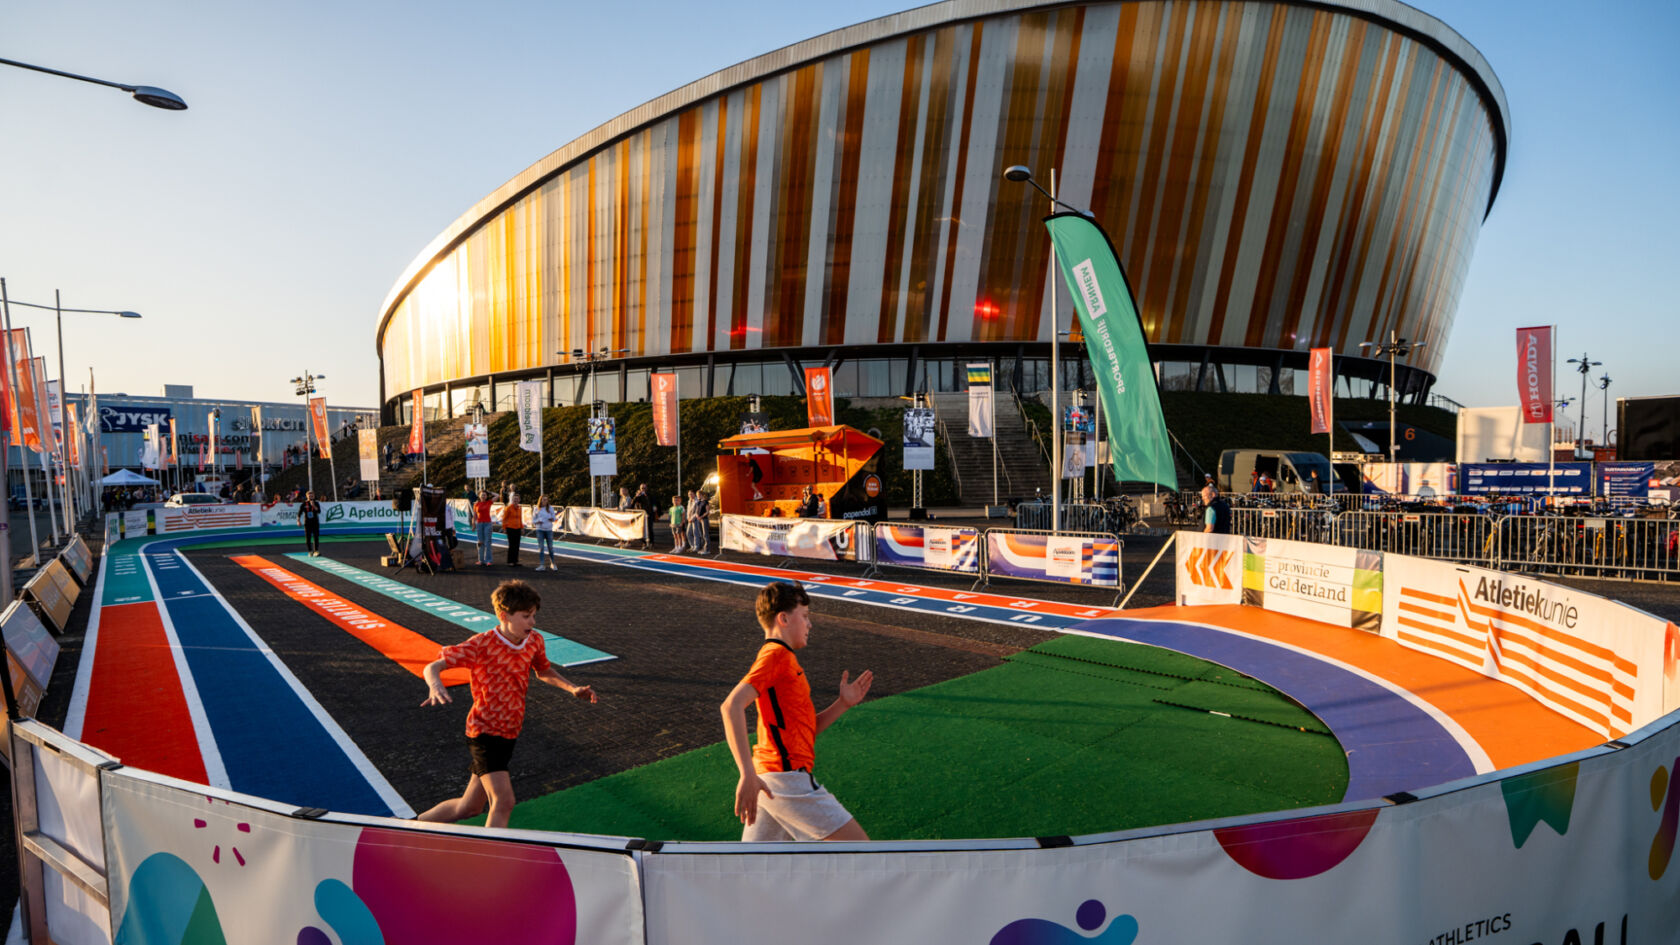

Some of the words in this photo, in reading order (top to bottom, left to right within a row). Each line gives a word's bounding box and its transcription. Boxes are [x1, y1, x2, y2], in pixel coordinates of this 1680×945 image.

[116, 412, 169, 426] JYSK
[1404, 428, 1416, 441] 6
[348, 506, 412, 521] Apeldoon
[1278, 561, 1330, 578] provincie
[1269, 575, 1347, 602] Gelderland
[1474, 576, 1578, 629] Atletiekunie
